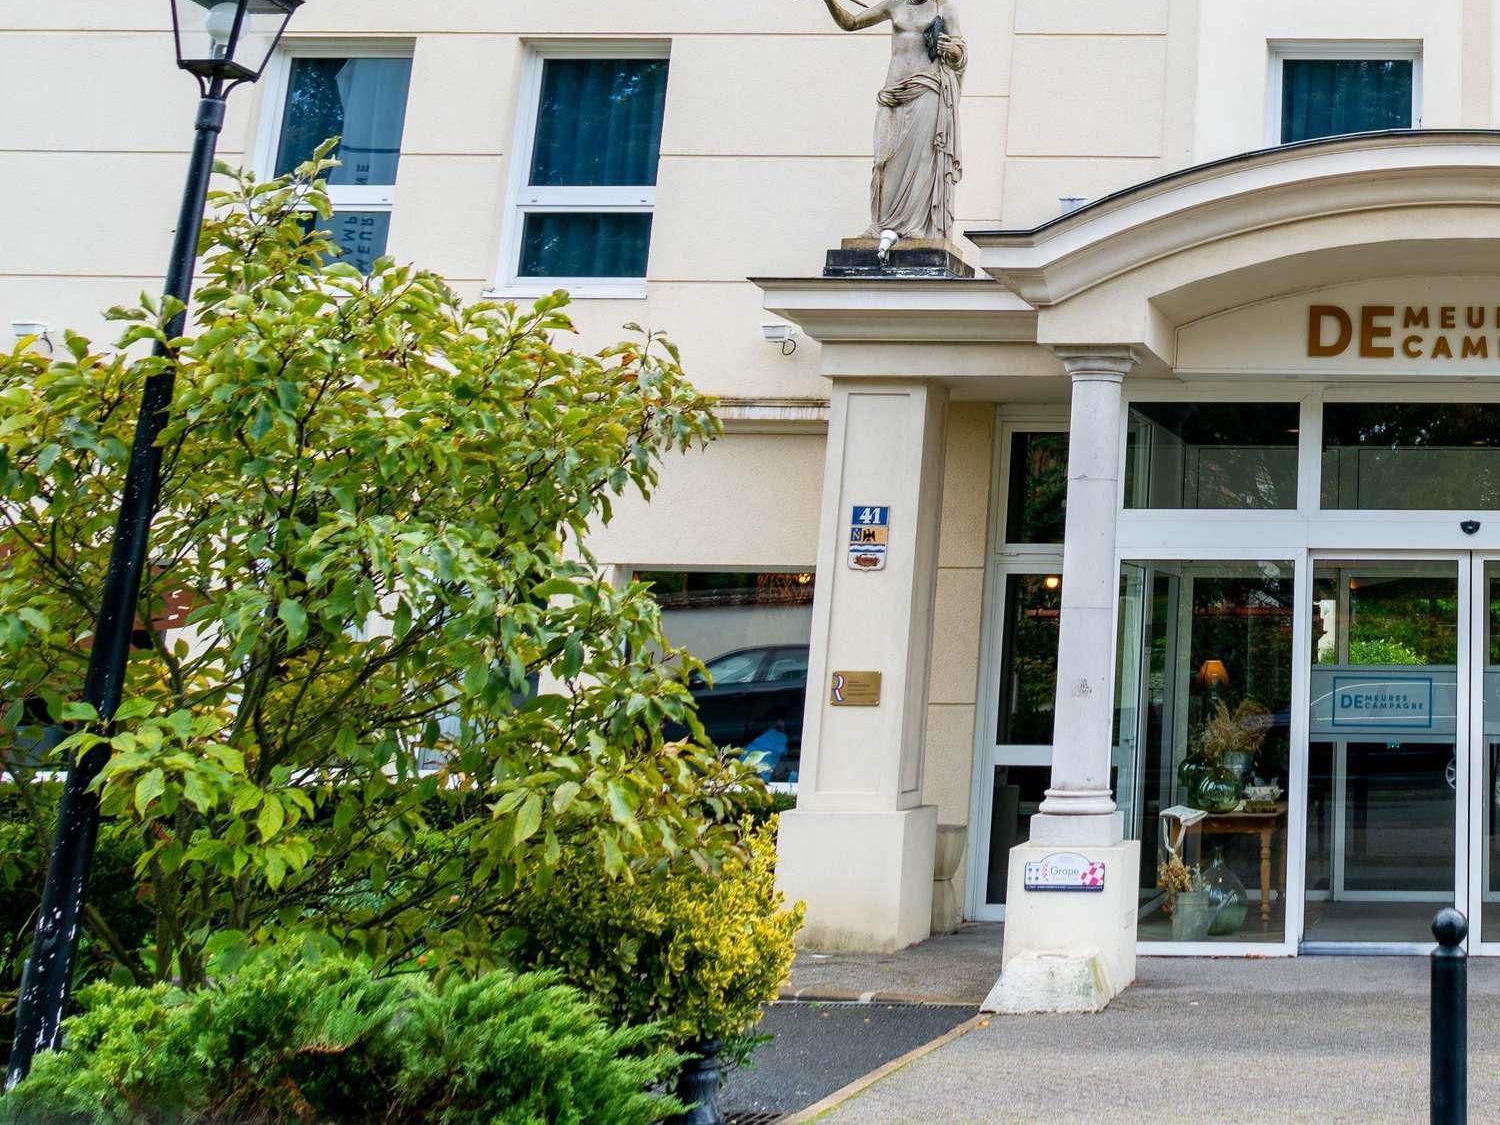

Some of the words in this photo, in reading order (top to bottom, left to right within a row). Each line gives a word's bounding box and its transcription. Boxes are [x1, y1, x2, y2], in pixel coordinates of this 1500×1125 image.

[1307, 305, 1395, 358] DE
[860, 507, 881, 524] 41
[1341, 694, 1363, 709] DE
[1364, 694, 1408, 702] MEURES
[1364, 702, 1423, 710] CAMPAGNE
